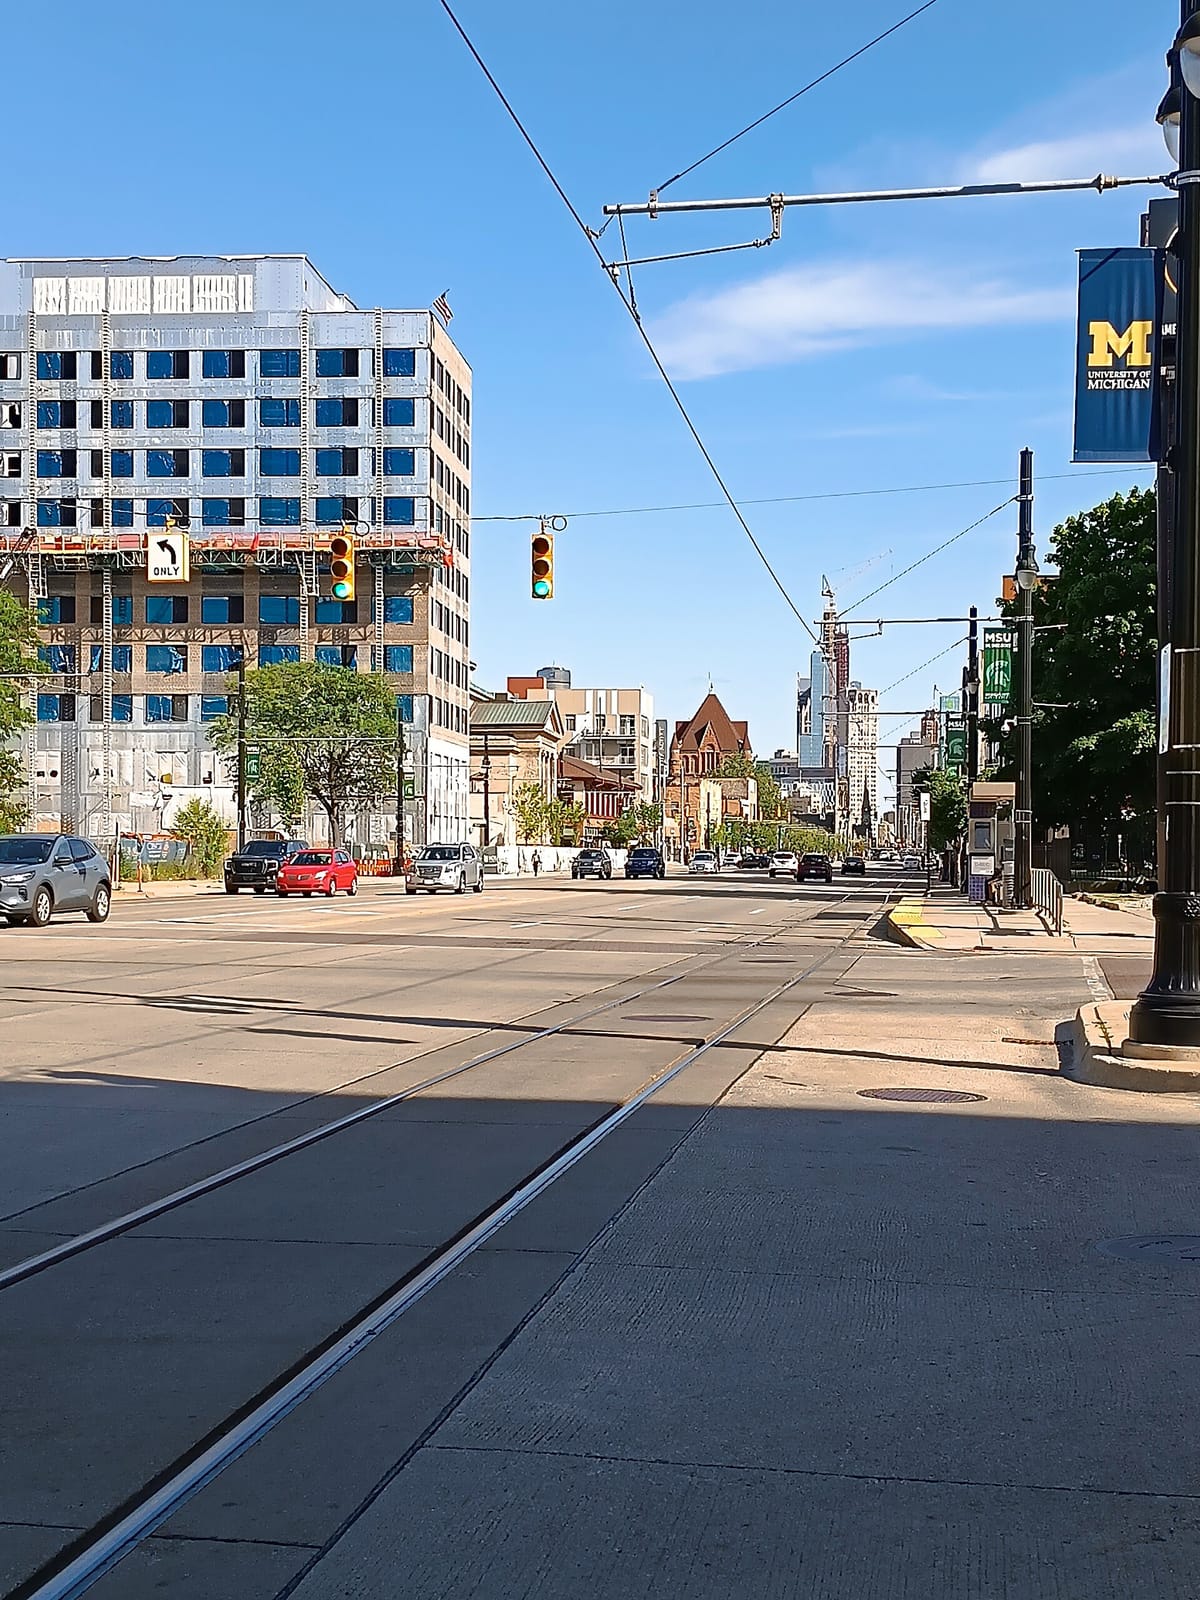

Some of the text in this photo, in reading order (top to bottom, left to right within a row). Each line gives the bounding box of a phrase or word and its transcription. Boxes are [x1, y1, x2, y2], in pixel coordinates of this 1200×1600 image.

[1088, 321, 1152, 366] M
[1088, 371, 1137, 379] UNIVERSITY
[1140, 371, 1151, 379] OF
[1088, 379, 1150, 389] MICHIGAN
[153, 566, 180, 576] ONLY
[985, 632, 1012, 643] MSU
